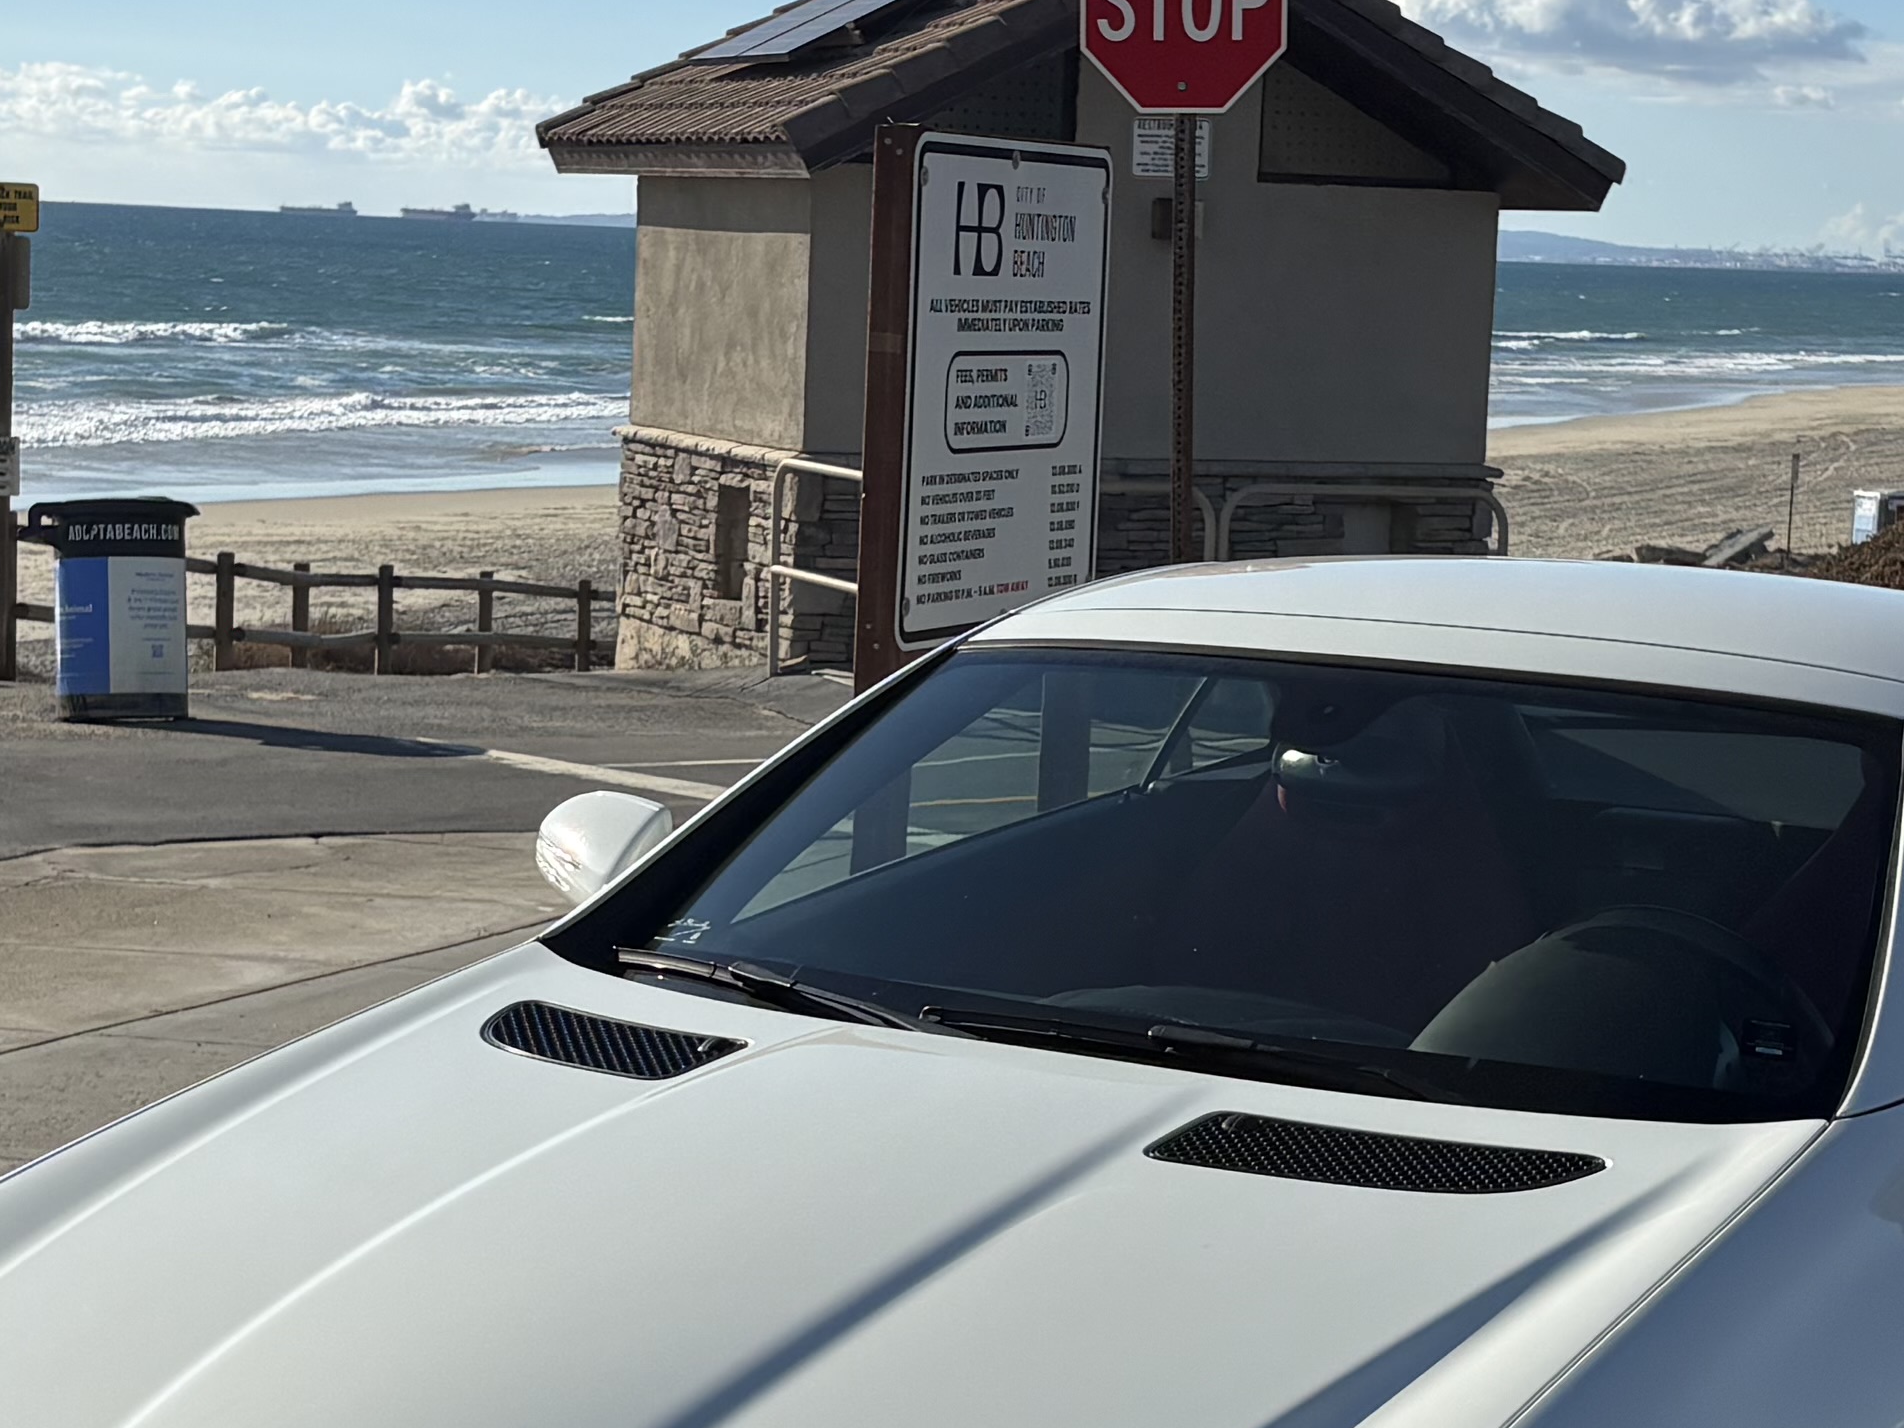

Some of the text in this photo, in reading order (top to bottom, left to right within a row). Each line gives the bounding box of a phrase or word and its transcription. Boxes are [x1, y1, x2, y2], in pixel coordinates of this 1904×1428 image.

[1016, 186, 1046, 204] CITY OF
[953, 181, 1005, 276] HB
[1014, 212, 1077, 243] HUNTINGTON
[1012, 249, 1045, 278] BEACH
[929, 299, 1091, 315] ALL VEHICLES MUST PAY ESTABLISHED RATES
[957, 318, 1064, 333] IMMEDIATELY UPON PARKING
[955, 368, 1008, 385] FEES, PERMITS
[954, 393, 1018, 410] AND ADDITIONAL
[953, 420, 1007, 436] INFORMATION
[921, 475, 937, 487] PARK
[946, 471, 981, 485] DESIGNATED
[982, 470, 1004, 482] SPACES
[1004, 468, 1020, 480] ONLY
[920, 495, 930, 506] NO
[931, 492, 958, 505] VEHICLES
[959, 491, 974, 503] OVER
[983, 489, 995, 501] FEET
[920, 515, 930, 526] NO
[930, 512, 956, 525] TRAILERS
[957, 511, 966, 523] OR
[989, 507, 1014, 520] VEHICLES
[919, 527, 996, 546] NO ALCOHOLIC BEVERAGES
[918, 548, 985, 566] NO GLASS CONTAINERS
[917, 569, 962, 585] NO FIREWORKS
[916, 594, 926, 605] NO
[926, 590, 953, 604] PARKING
